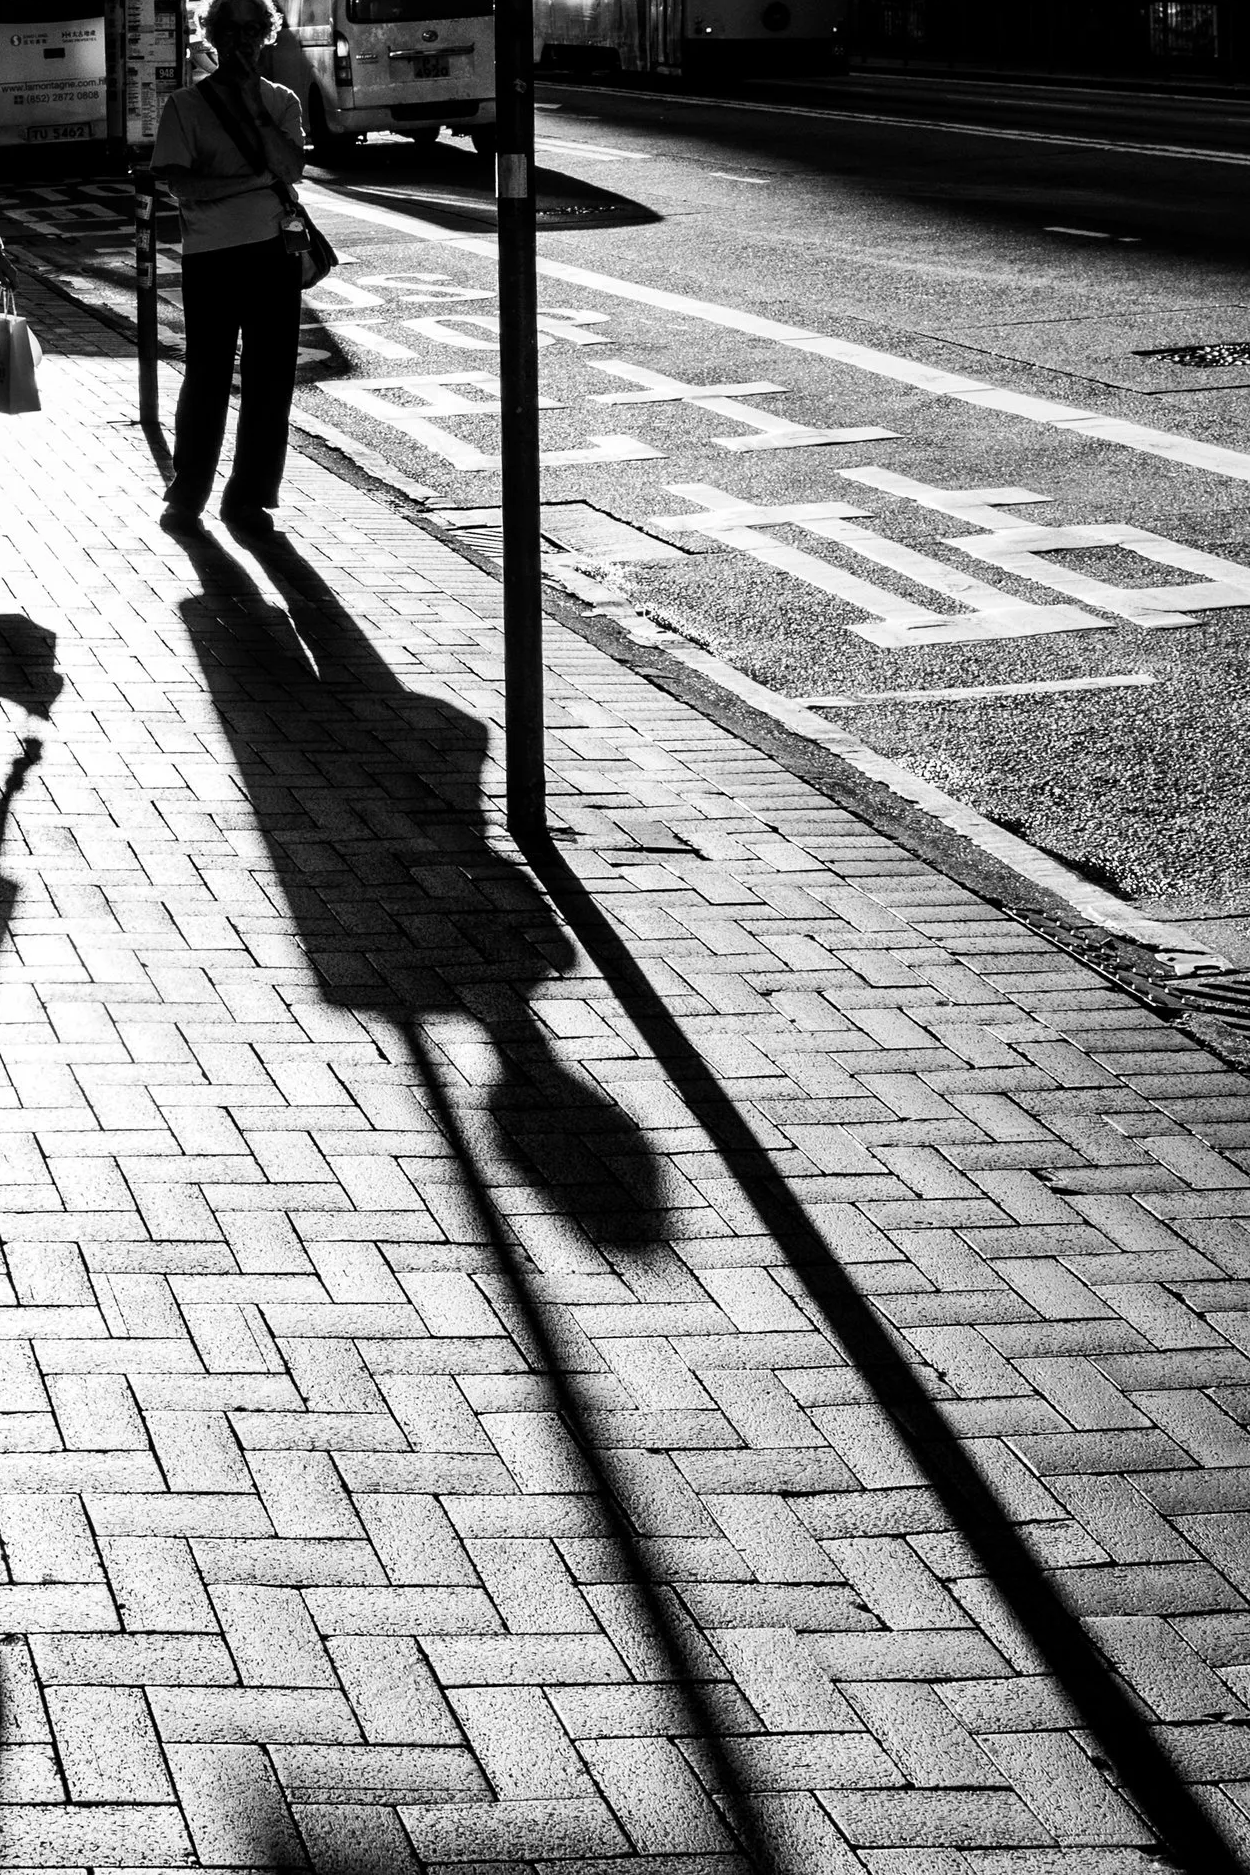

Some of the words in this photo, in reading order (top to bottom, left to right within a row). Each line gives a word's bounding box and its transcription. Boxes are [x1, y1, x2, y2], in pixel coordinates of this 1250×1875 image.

[158, 68, 175, 78] 948
[27, 94, 50, 105] (852)
[52, 92, 74, 102] 2872
[77, 91, 99, 100] 0808
[32, 129, 47, 140] TU
[54, 127, 84, 139] 5462
